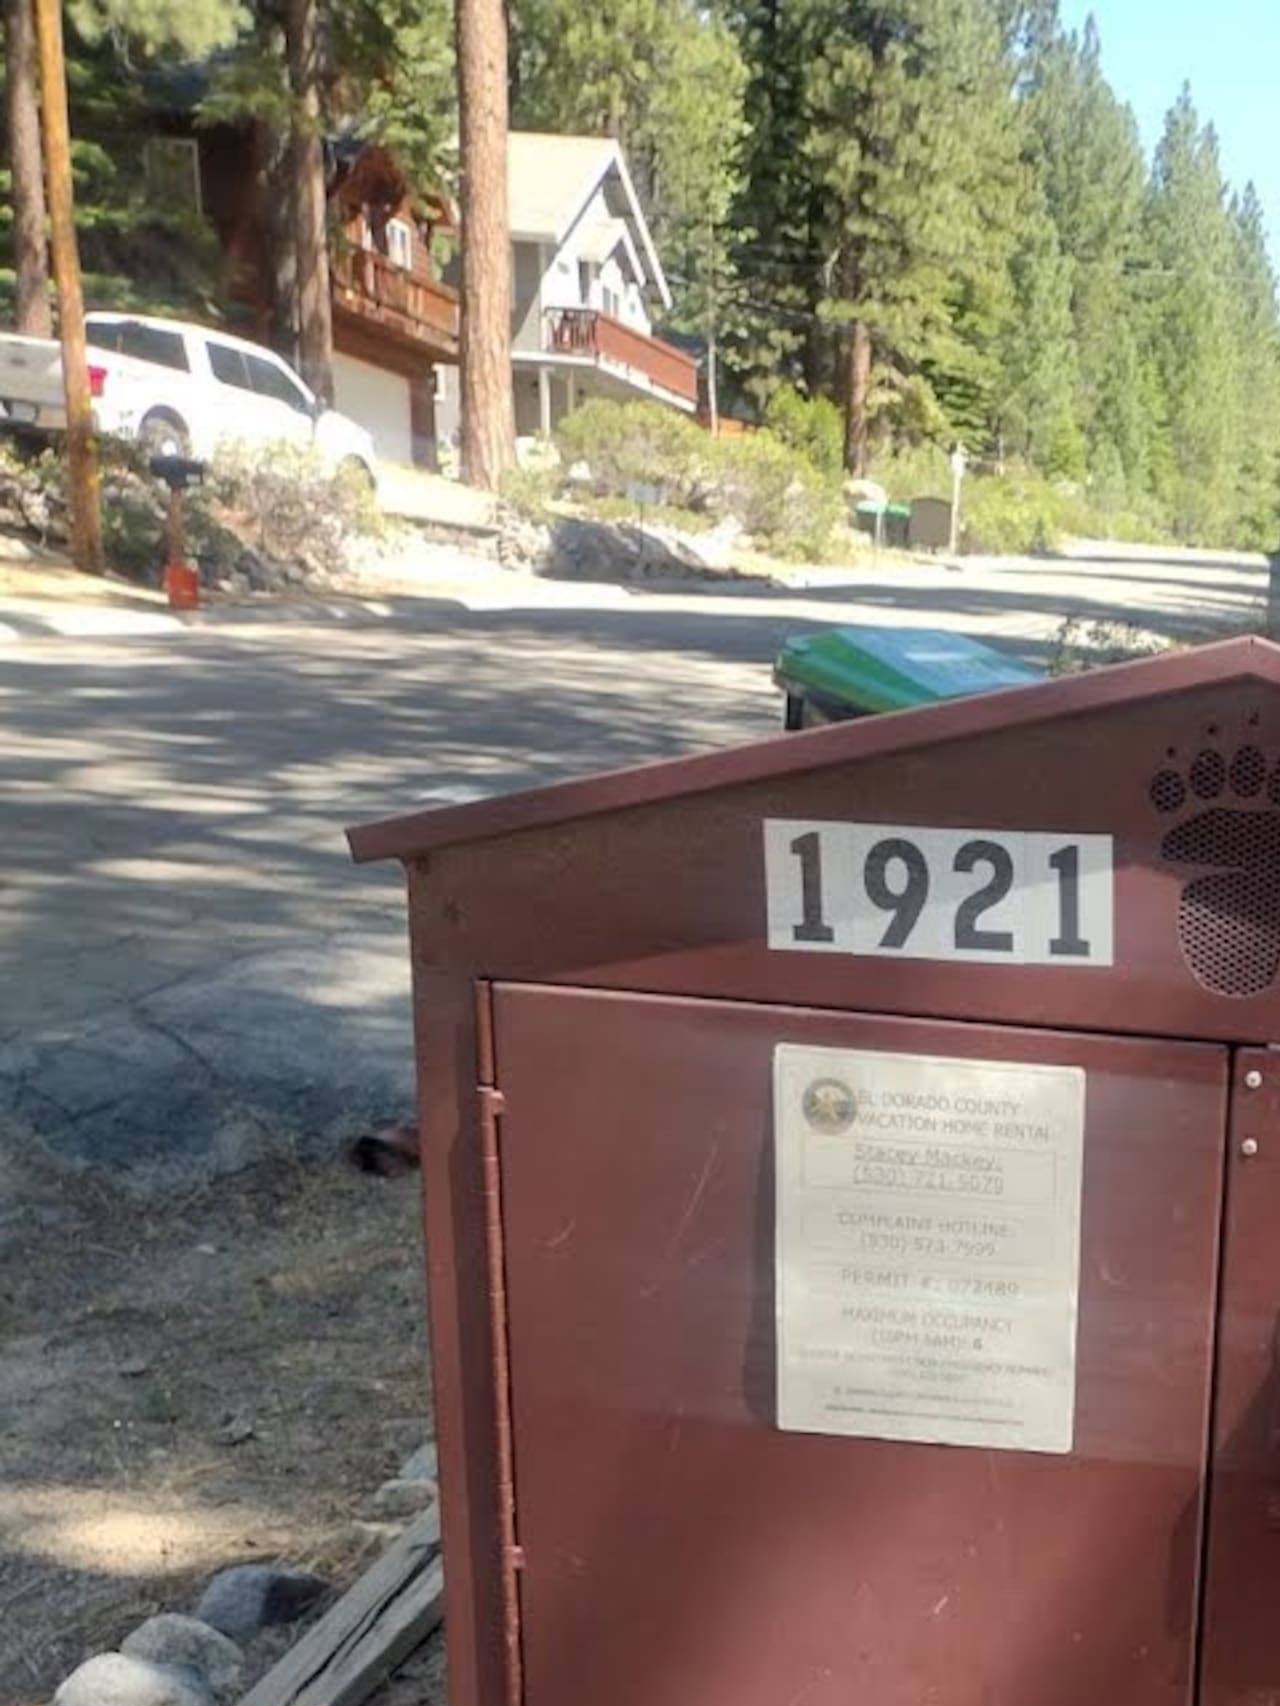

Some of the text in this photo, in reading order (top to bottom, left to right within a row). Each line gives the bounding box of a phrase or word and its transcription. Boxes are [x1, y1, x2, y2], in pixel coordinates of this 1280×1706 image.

[790, 831, 1090, 956] 1921
[881, 1091, 951, 1112] DORADO
[953, 1096, 1021, 1117] COUNTY
[857, 1111, 1050, 1143] VACATION HOME RENTAL
[838, 1212, 933, 1231] COMPLAINT
[841, 1267, 909, 1289] PERMIT
[842, 1306, 1013, 1333] MAXIMUM OCCUPANCY
